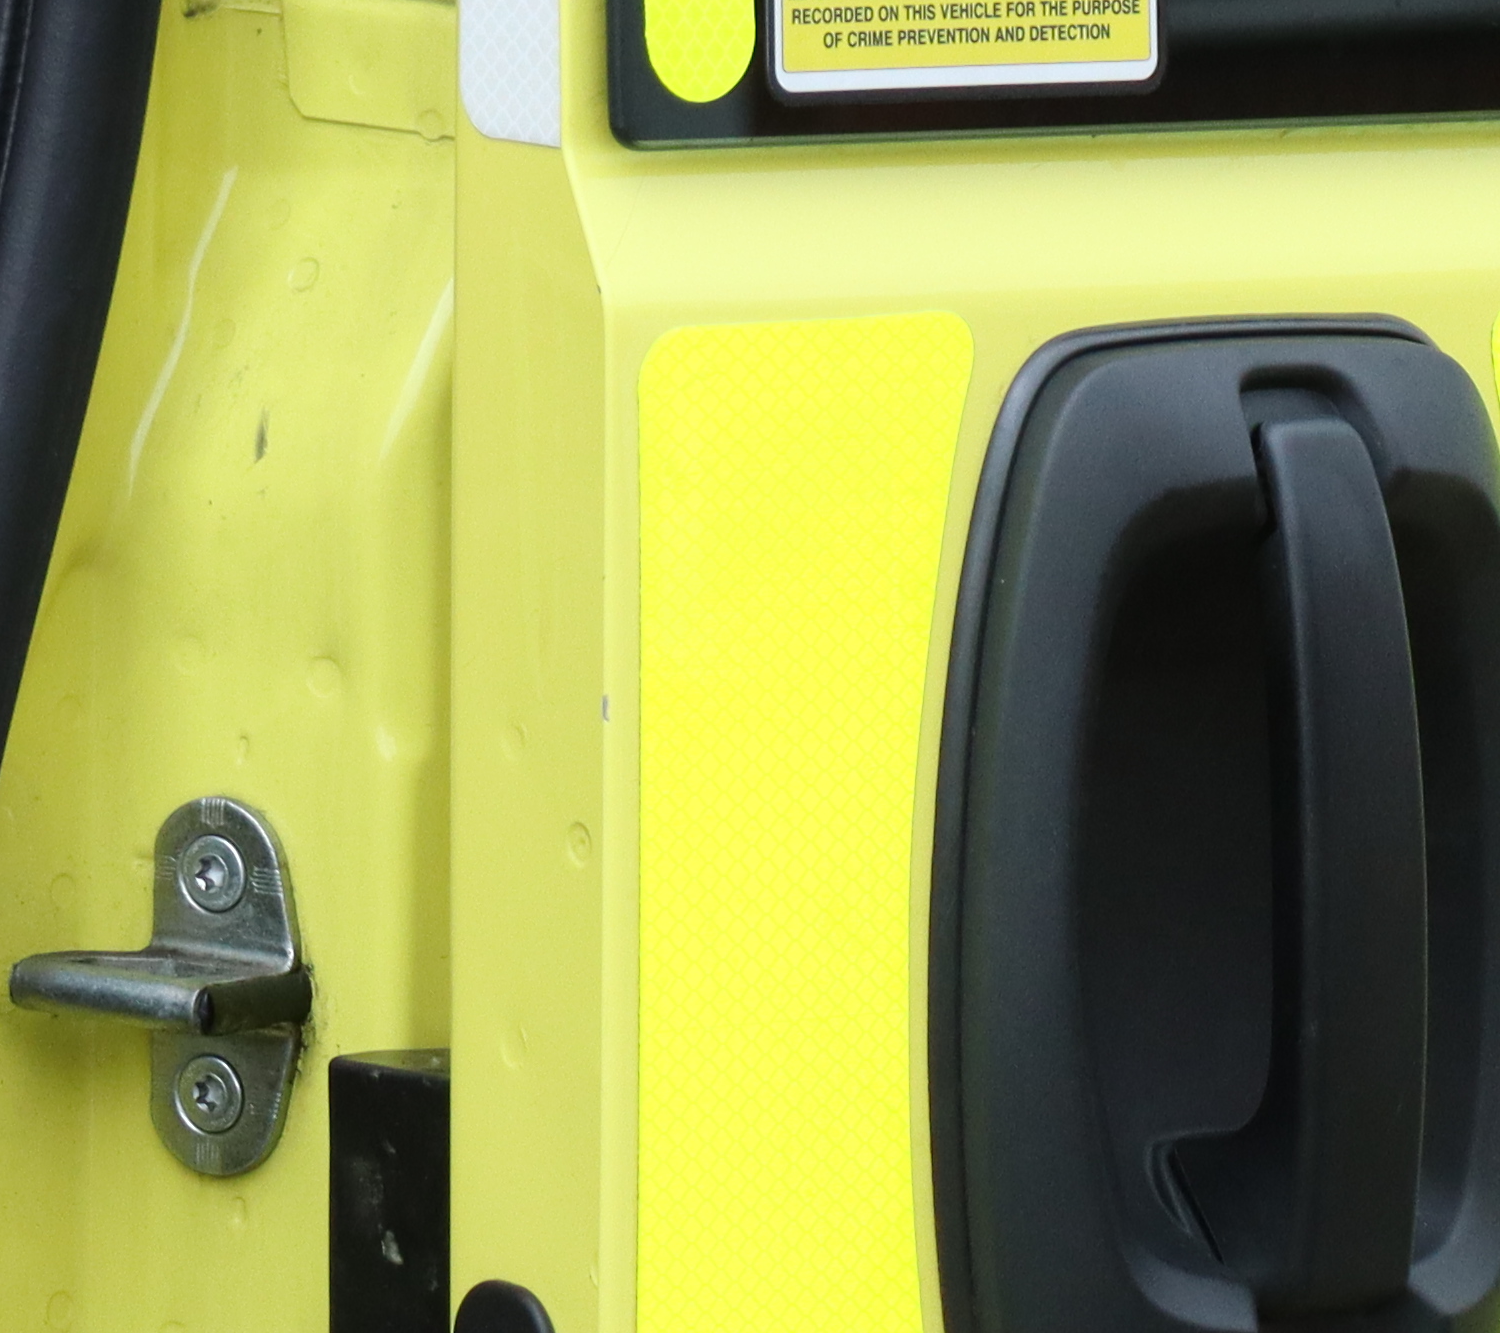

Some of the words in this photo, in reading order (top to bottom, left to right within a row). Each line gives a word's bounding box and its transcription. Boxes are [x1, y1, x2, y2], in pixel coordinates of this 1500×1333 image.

[791, 5, 874, 25] RECORDED
[877, 5, 899, 23] ON
[903, 3, 936, 21] THIS
[939, 1, 1002, 20] VEHICLE
[1006, 0, 1036, 18] FOR
[1039, 0, 1068, 17] THE
[823, 31, 843, 49] OF
[847, 29, 893, 48] CRIME
[897, 26, 990, 46] PREVENTION
[994, 25, 1026, 43] AND
[1029, 23, 1111, 42] DETECTION
